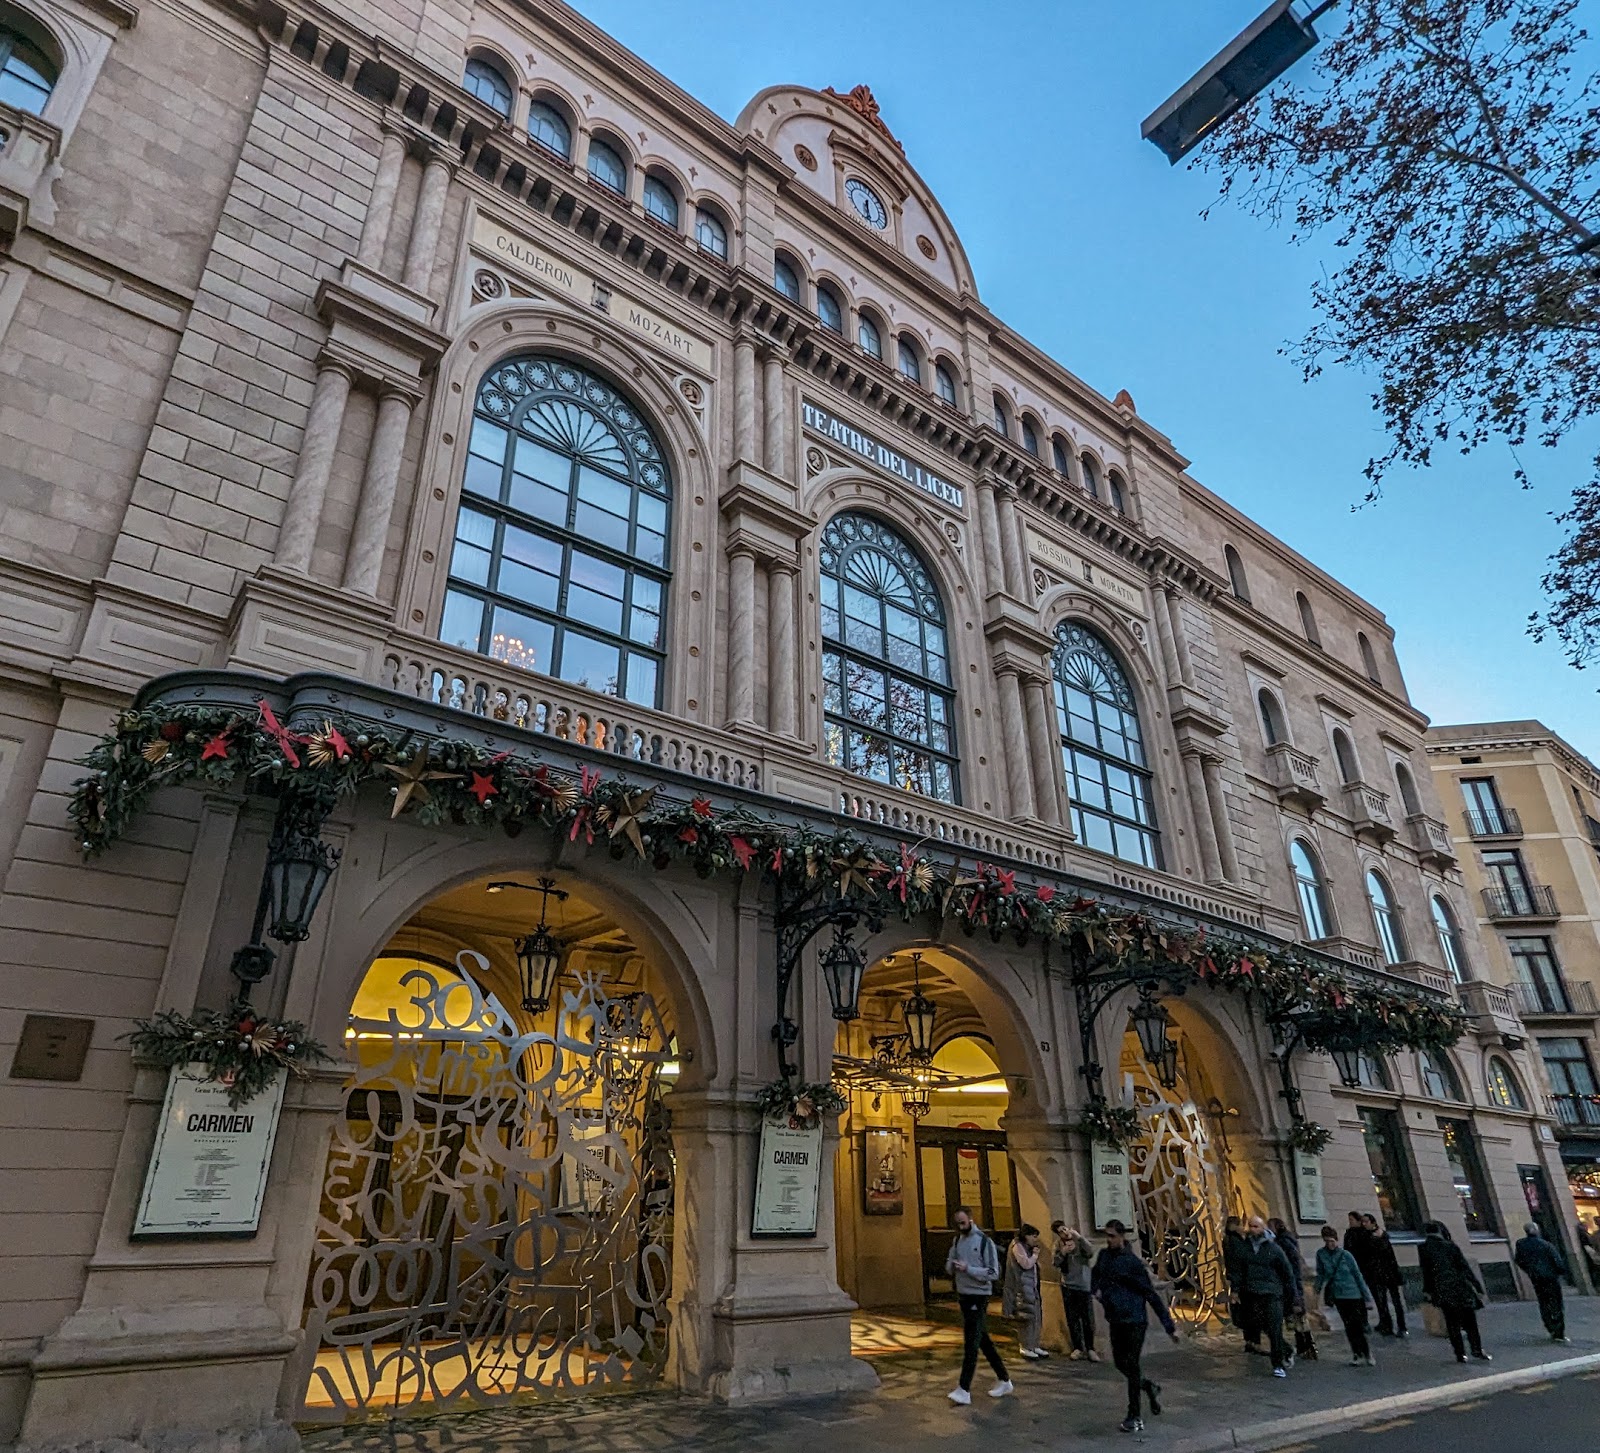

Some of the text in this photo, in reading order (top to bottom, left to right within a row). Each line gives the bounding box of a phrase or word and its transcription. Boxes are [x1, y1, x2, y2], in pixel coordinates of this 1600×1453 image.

[496, 235, 573, 288] CALDERON
[629, 309, 693, 354] MOZART
[802, 402, 963, 508] TEATRE DEL LICEU
[1037, 540, 1072, 569] ROSSINI
[1100, 575, 1134, 602] MORATIN
[187, 1113, 255, 1133] CARMEN
[773, 1150, 809, 1166] CARMEN
